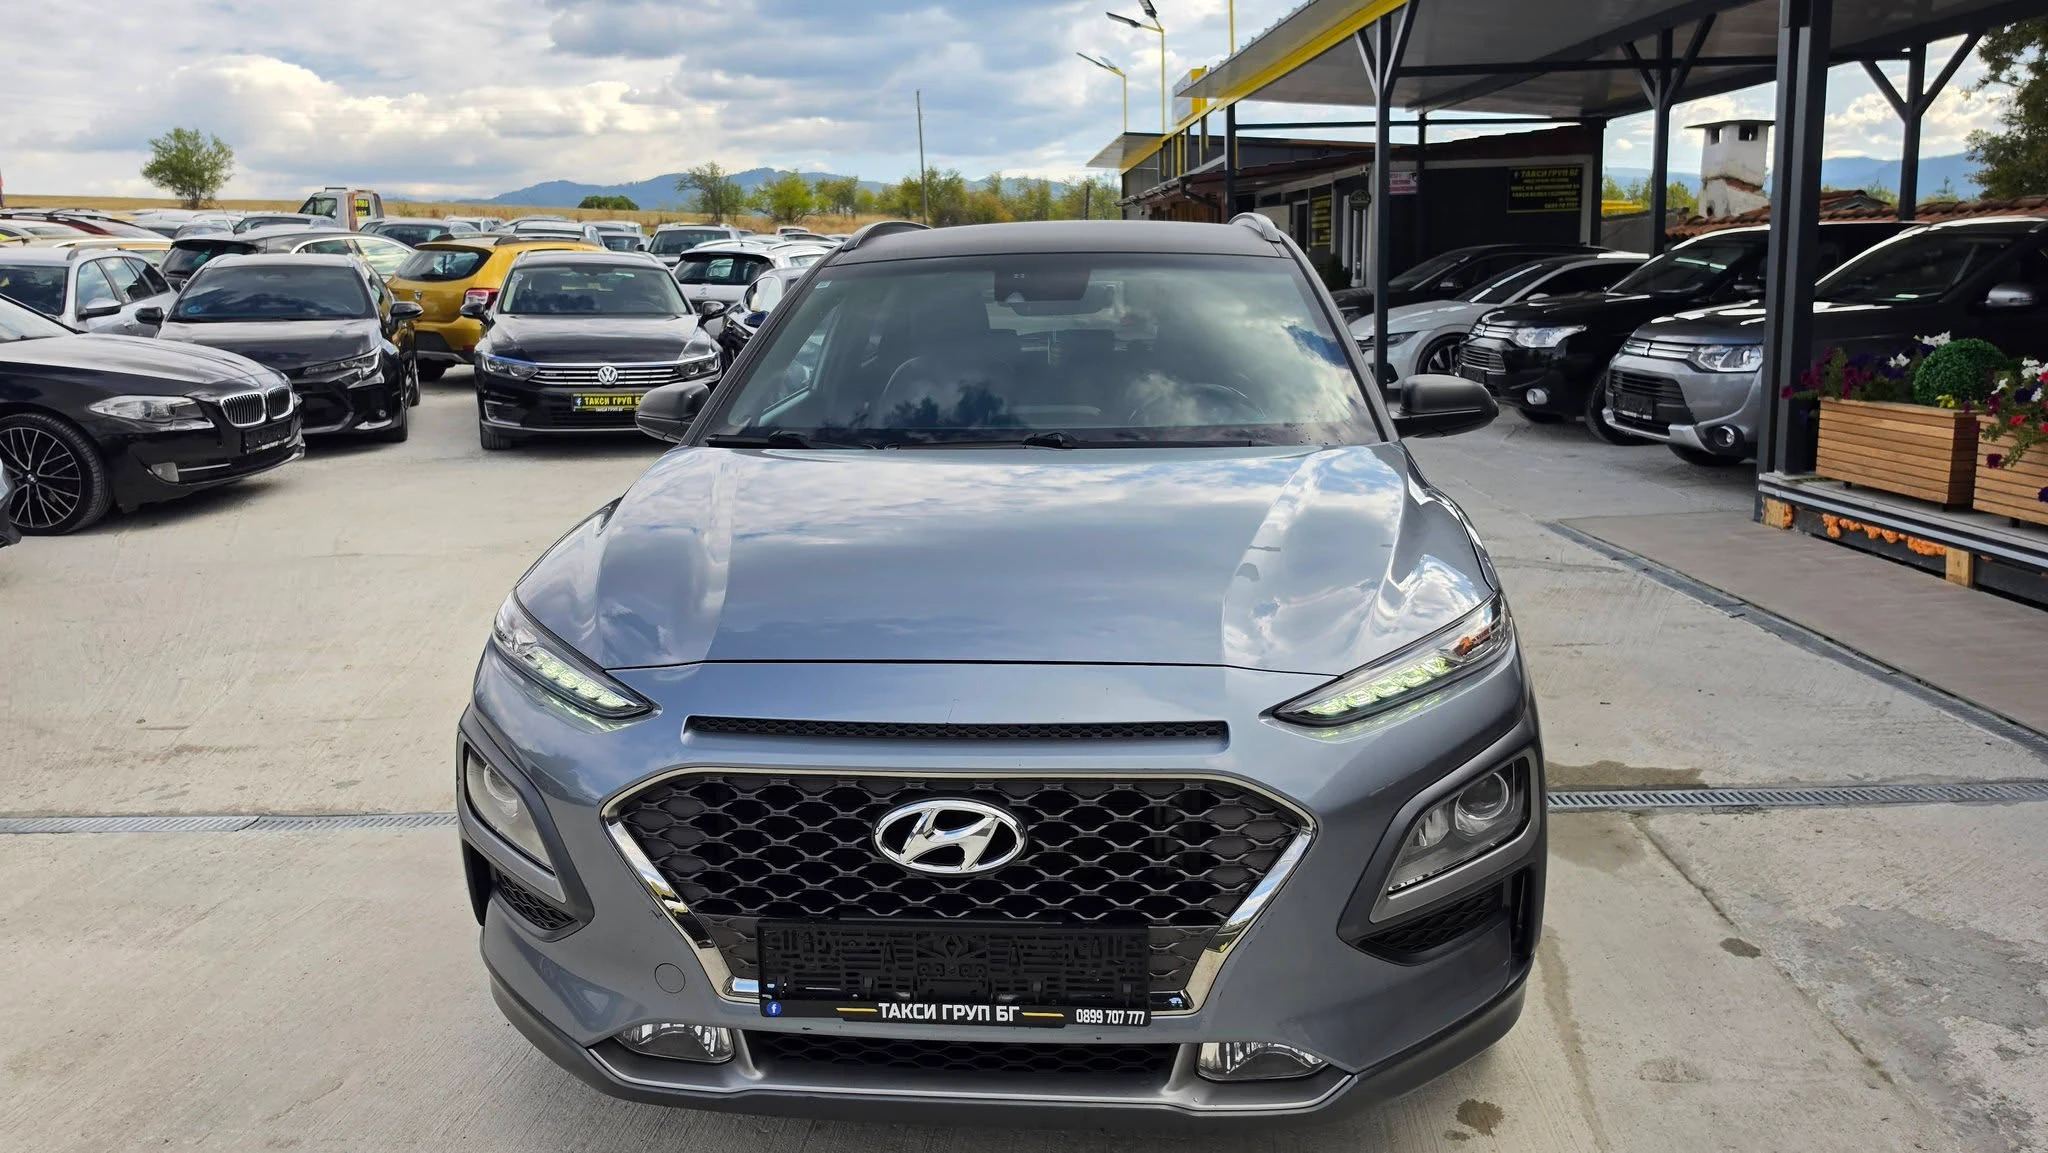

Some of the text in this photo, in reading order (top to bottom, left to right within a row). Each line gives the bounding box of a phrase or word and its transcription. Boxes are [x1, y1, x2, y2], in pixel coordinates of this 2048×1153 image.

[584, 396, 610, 405] ТАКСИ
[612, 396, 632, 405] ГРУП
[878, 1003, 1020, 1022] ТАКСИ ГРУП БГ
[1075, 1008, 1146, 1025] 0899 707 777
